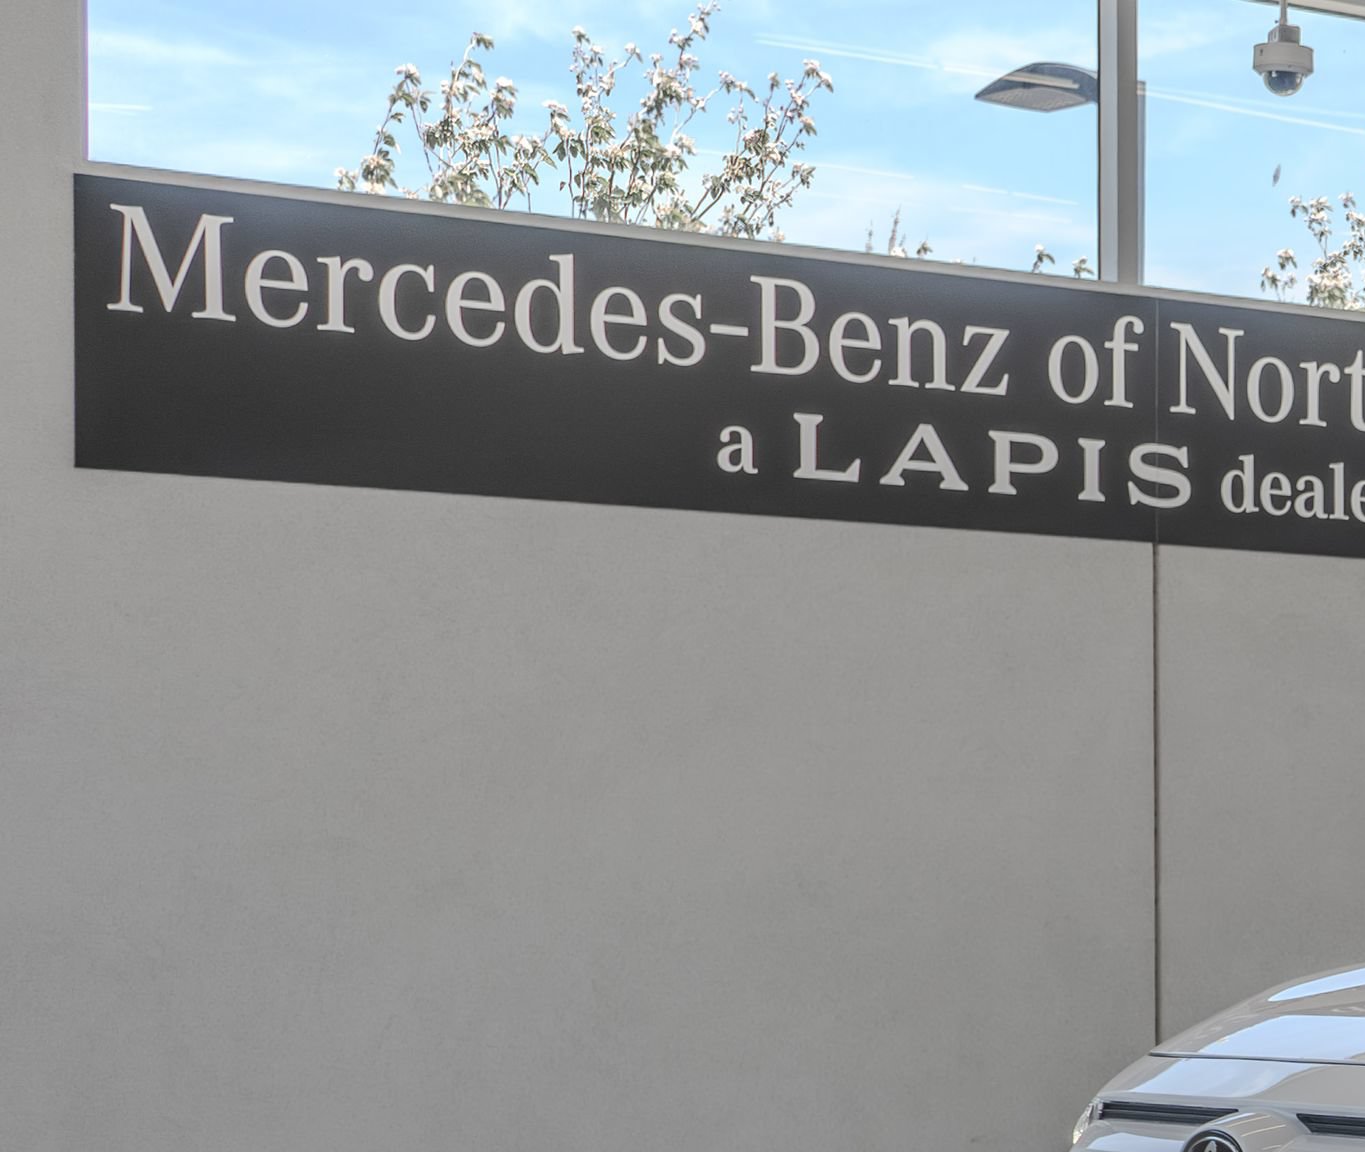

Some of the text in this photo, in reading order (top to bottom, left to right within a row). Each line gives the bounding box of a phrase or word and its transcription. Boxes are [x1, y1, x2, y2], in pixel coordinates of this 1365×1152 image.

[107, 203, 1010, 395] Mercedes-Benz
[1048, 315, 1144, 408] of
[717, 426, 758, 474] a
[793, 413, 1191, 508] LAPIS
